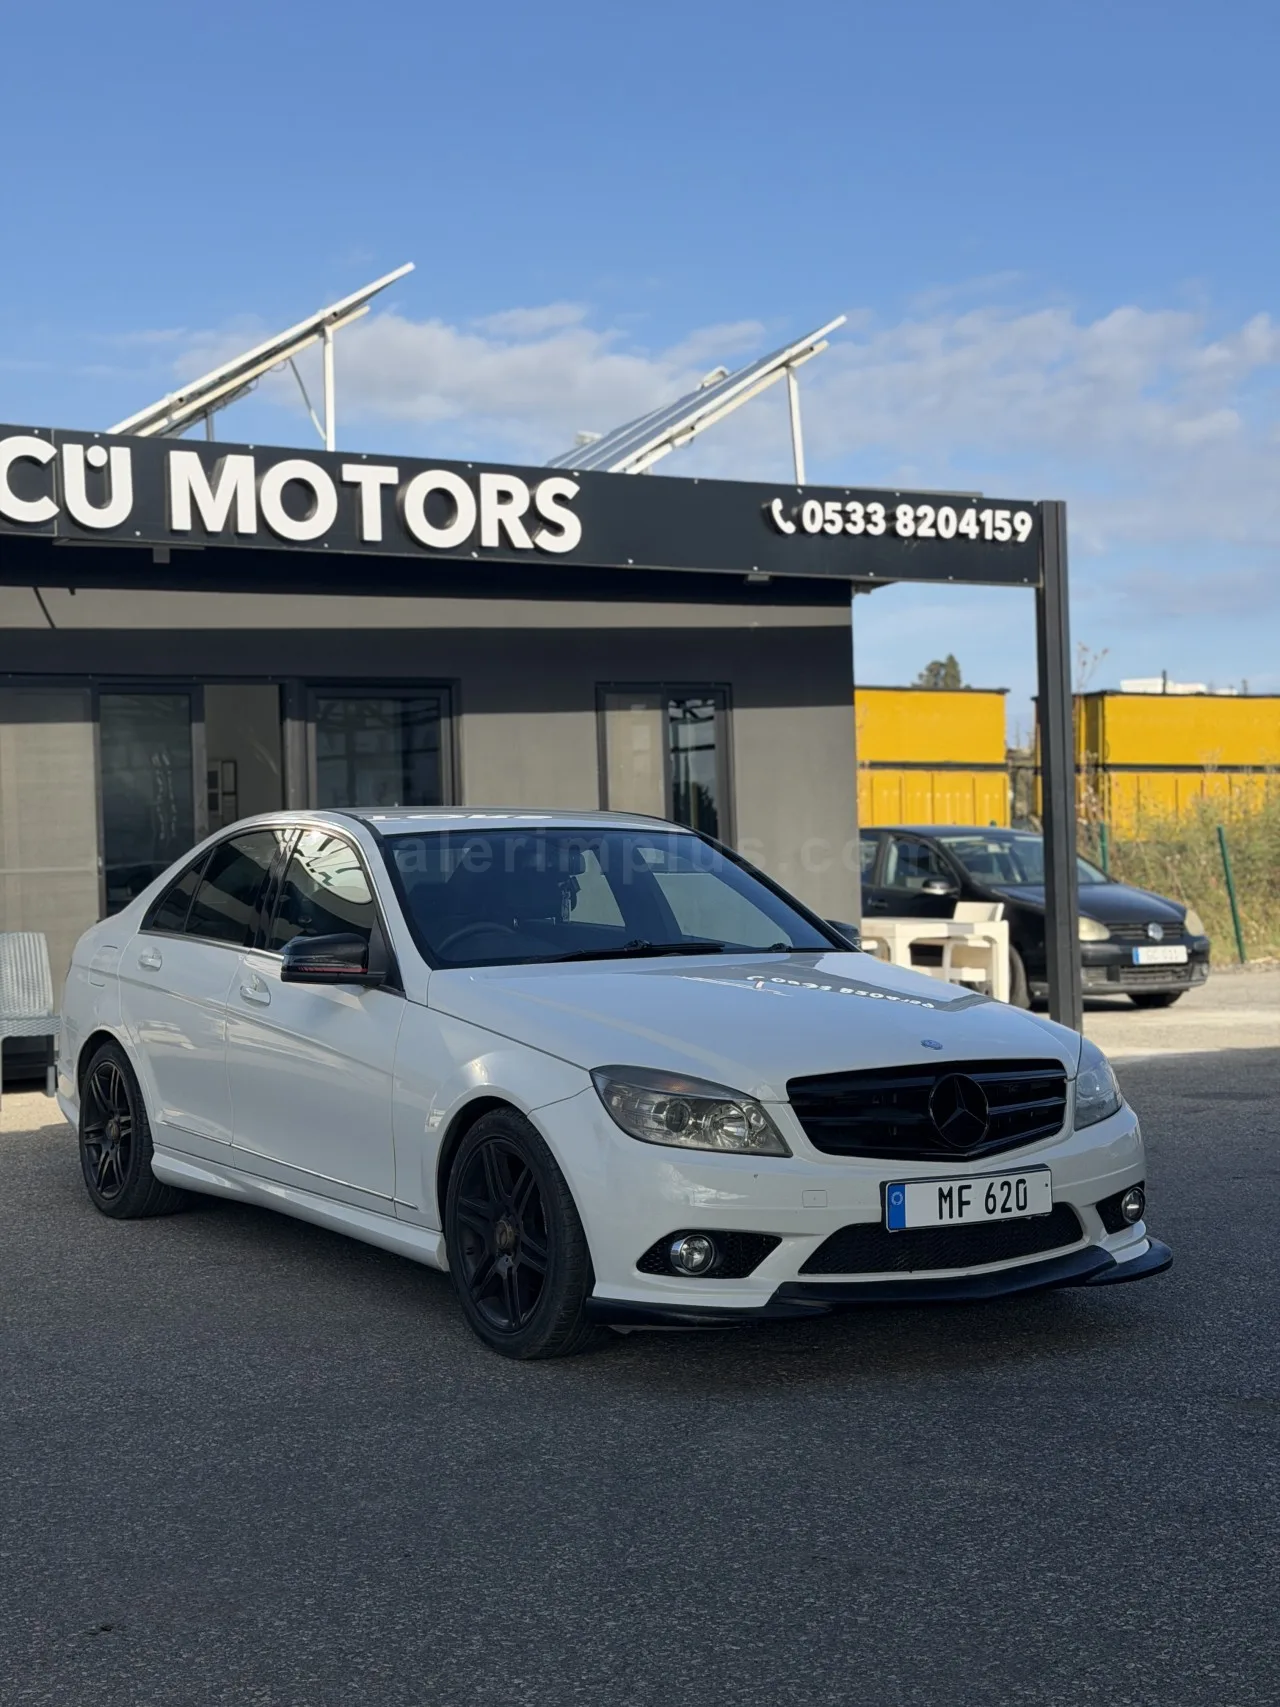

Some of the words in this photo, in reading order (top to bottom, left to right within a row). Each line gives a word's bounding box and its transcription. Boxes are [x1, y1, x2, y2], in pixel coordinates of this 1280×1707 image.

[168, 450, 582, 553] MOTORS
[802, 500, 886, 536] 0533
[895, 504, 1033, 542] 8204159
[937, 1184, 973, 1220] MF
[984, 1178, 1028, 1215] 620
